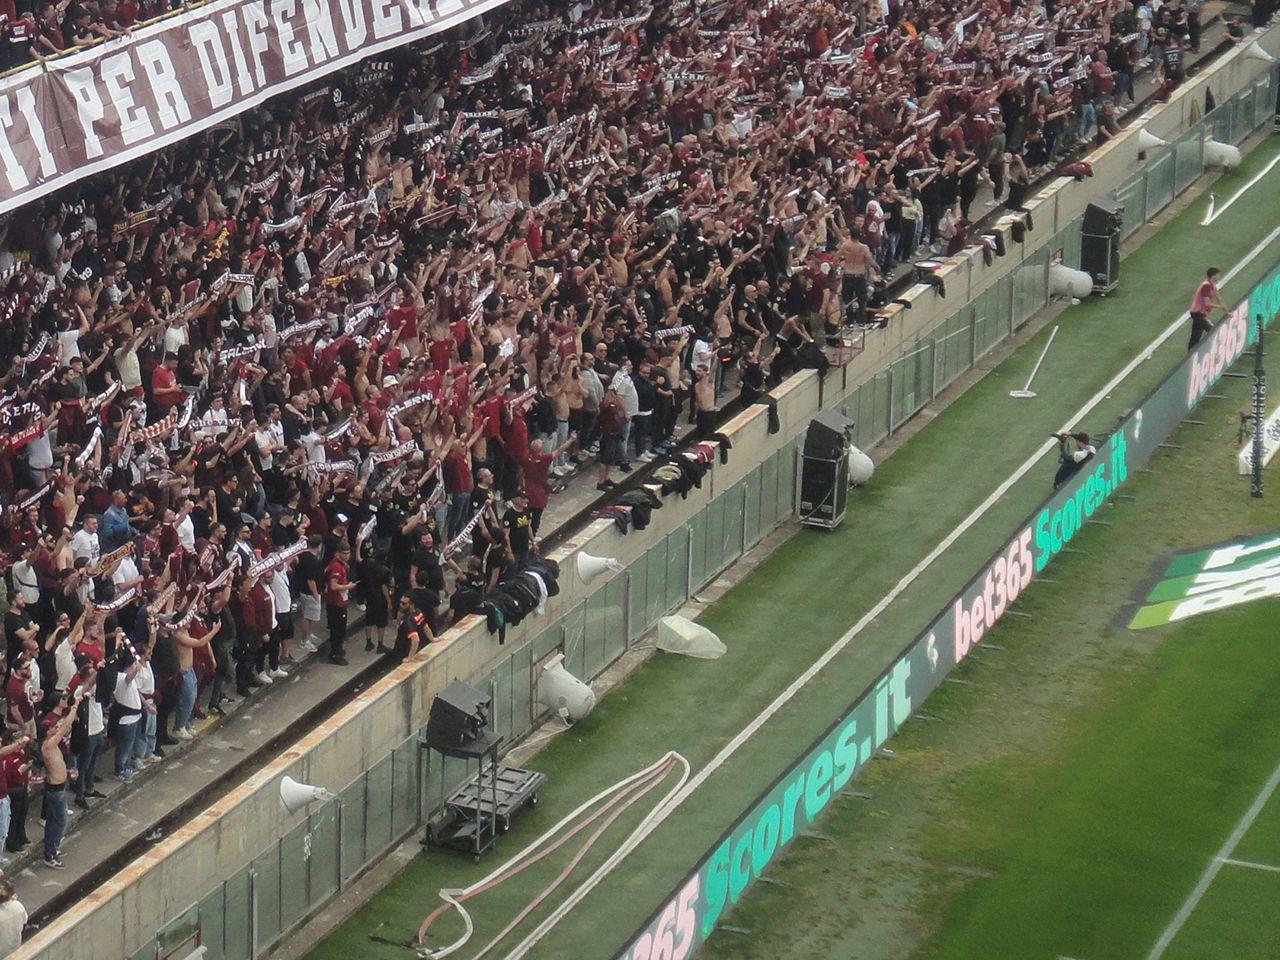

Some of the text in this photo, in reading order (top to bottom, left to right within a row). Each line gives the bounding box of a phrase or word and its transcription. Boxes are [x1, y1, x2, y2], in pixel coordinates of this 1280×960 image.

[63, 39, 192, 160] PER
[1187, 299, 1249, 409] bet365
[954, 428, 1128, 664] bet365 Scores.it
[702, 657, 912, 940] Scores.it
